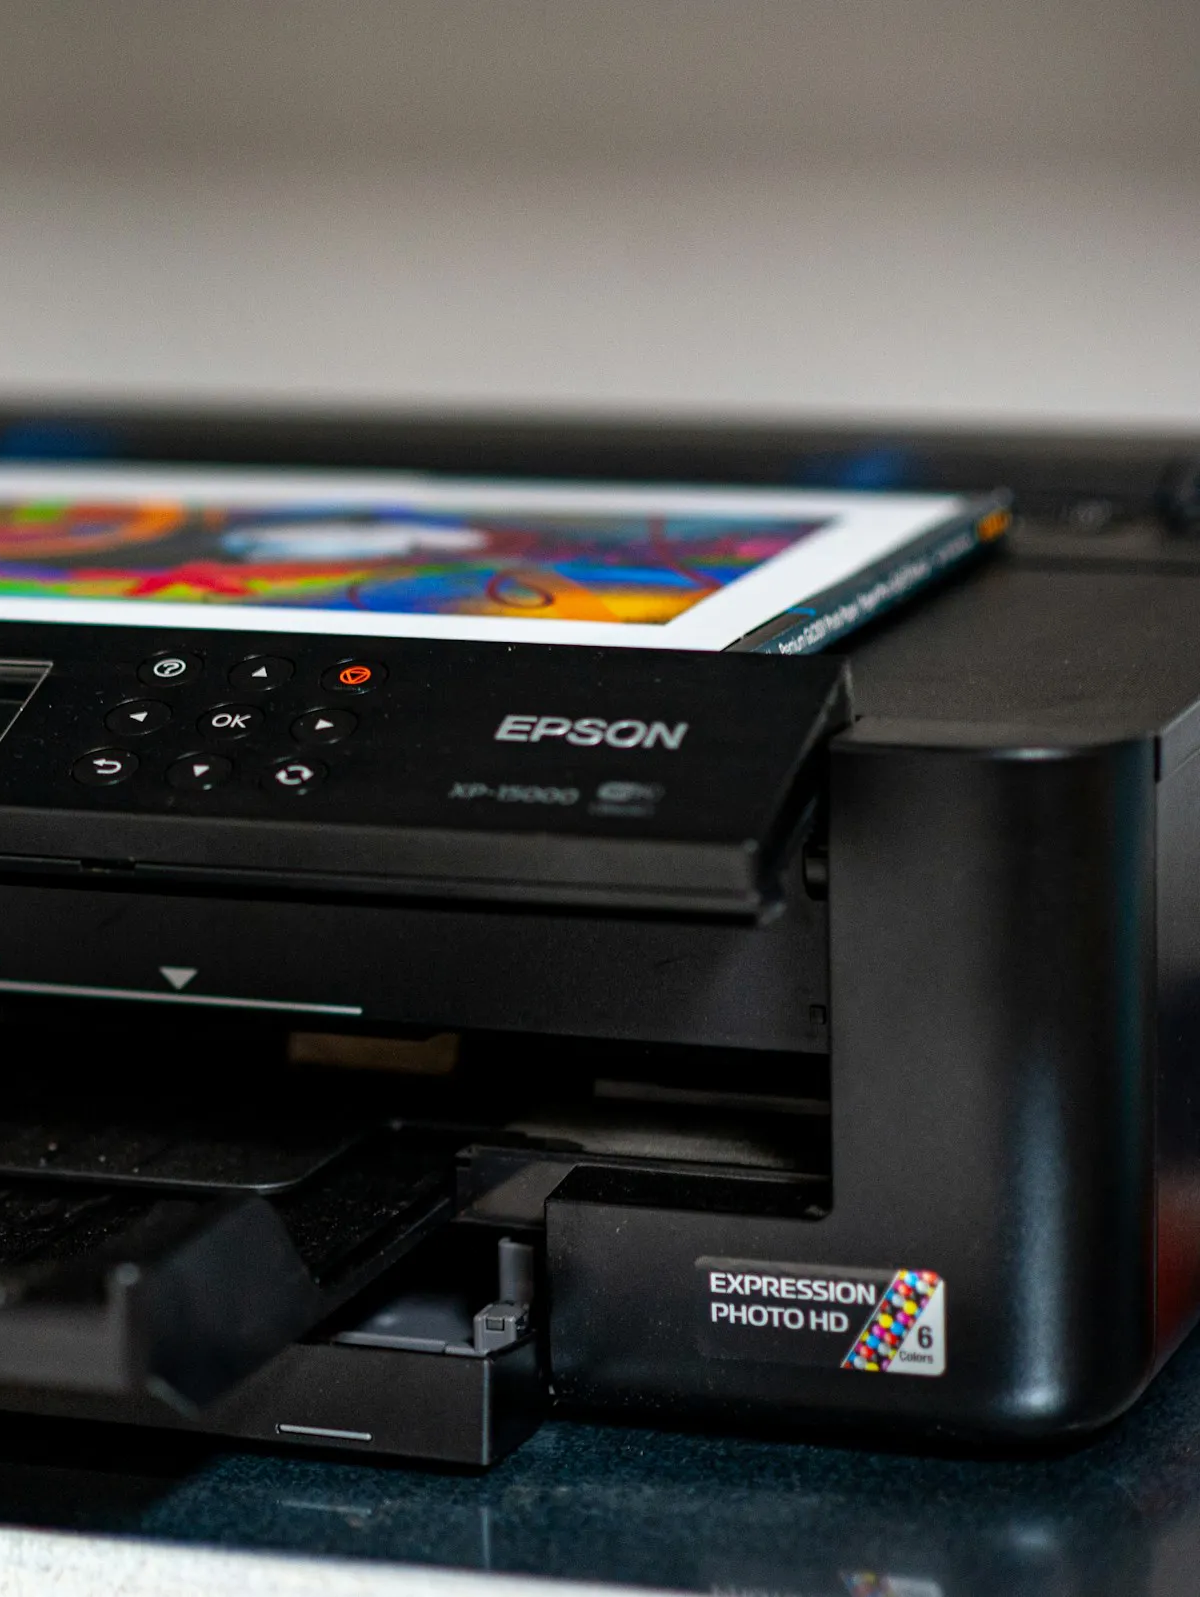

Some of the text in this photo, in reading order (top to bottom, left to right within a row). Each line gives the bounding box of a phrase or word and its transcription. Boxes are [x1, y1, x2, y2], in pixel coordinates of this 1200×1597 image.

[211, 712, 252, 729] OK
[494, 714, 689, 750] EPSON
[709, 1271, 876, 1305] EXPRESSION
[710, 1302, 849, 1333] PHOTO HD
[917, 1326, 933, 1349] 6
[899, 1350, 933, 1364] Colors
